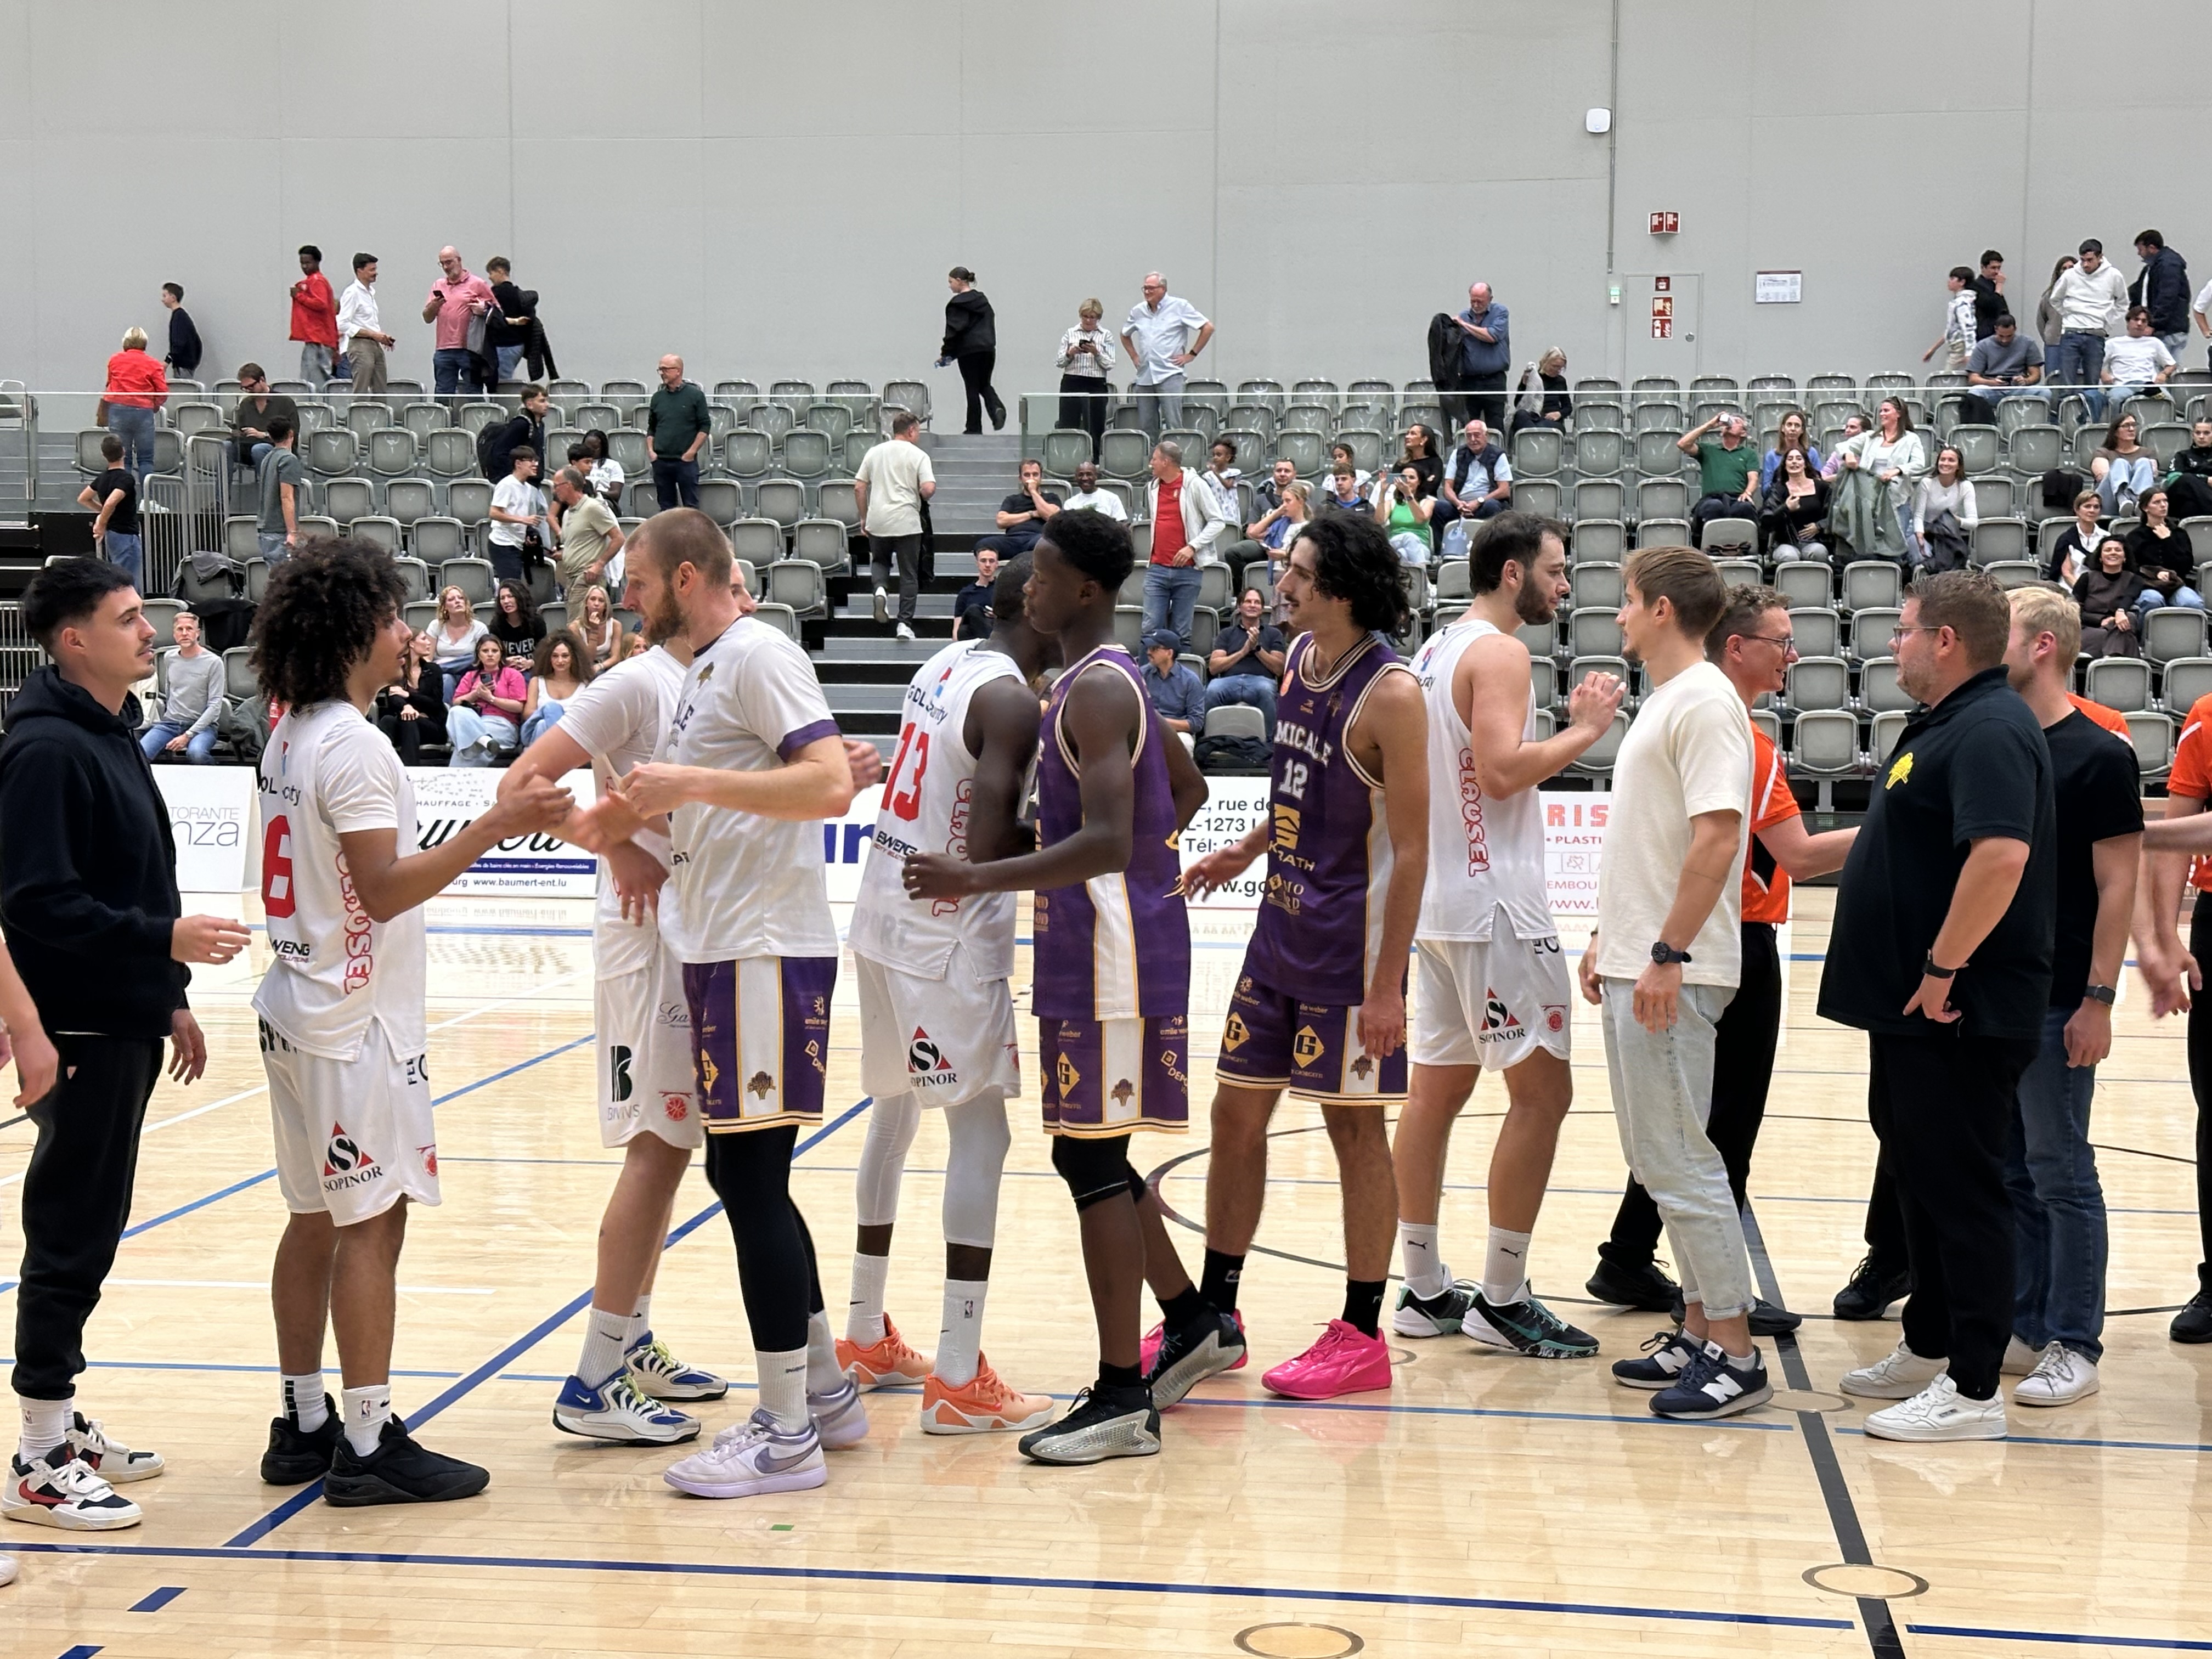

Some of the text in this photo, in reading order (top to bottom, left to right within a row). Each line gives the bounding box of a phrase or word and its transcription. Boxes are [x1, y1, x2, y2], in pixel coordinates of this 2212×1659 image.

[907, 685, 925, 707] GDL
[881, 721, 929, 821] 13
[1278, 758, 1310, 801] 12
[1218, 800, 1248, 811] rue
[1547, 804, 1609, 827] RIS
[1555, 836, 1602, 844] PLASTI
[261, 814, 296, 918] 6
[473, 879, 567, 887] www.baumert-ent.lu
[323, 1165, 383, 1193] SOPINOR
